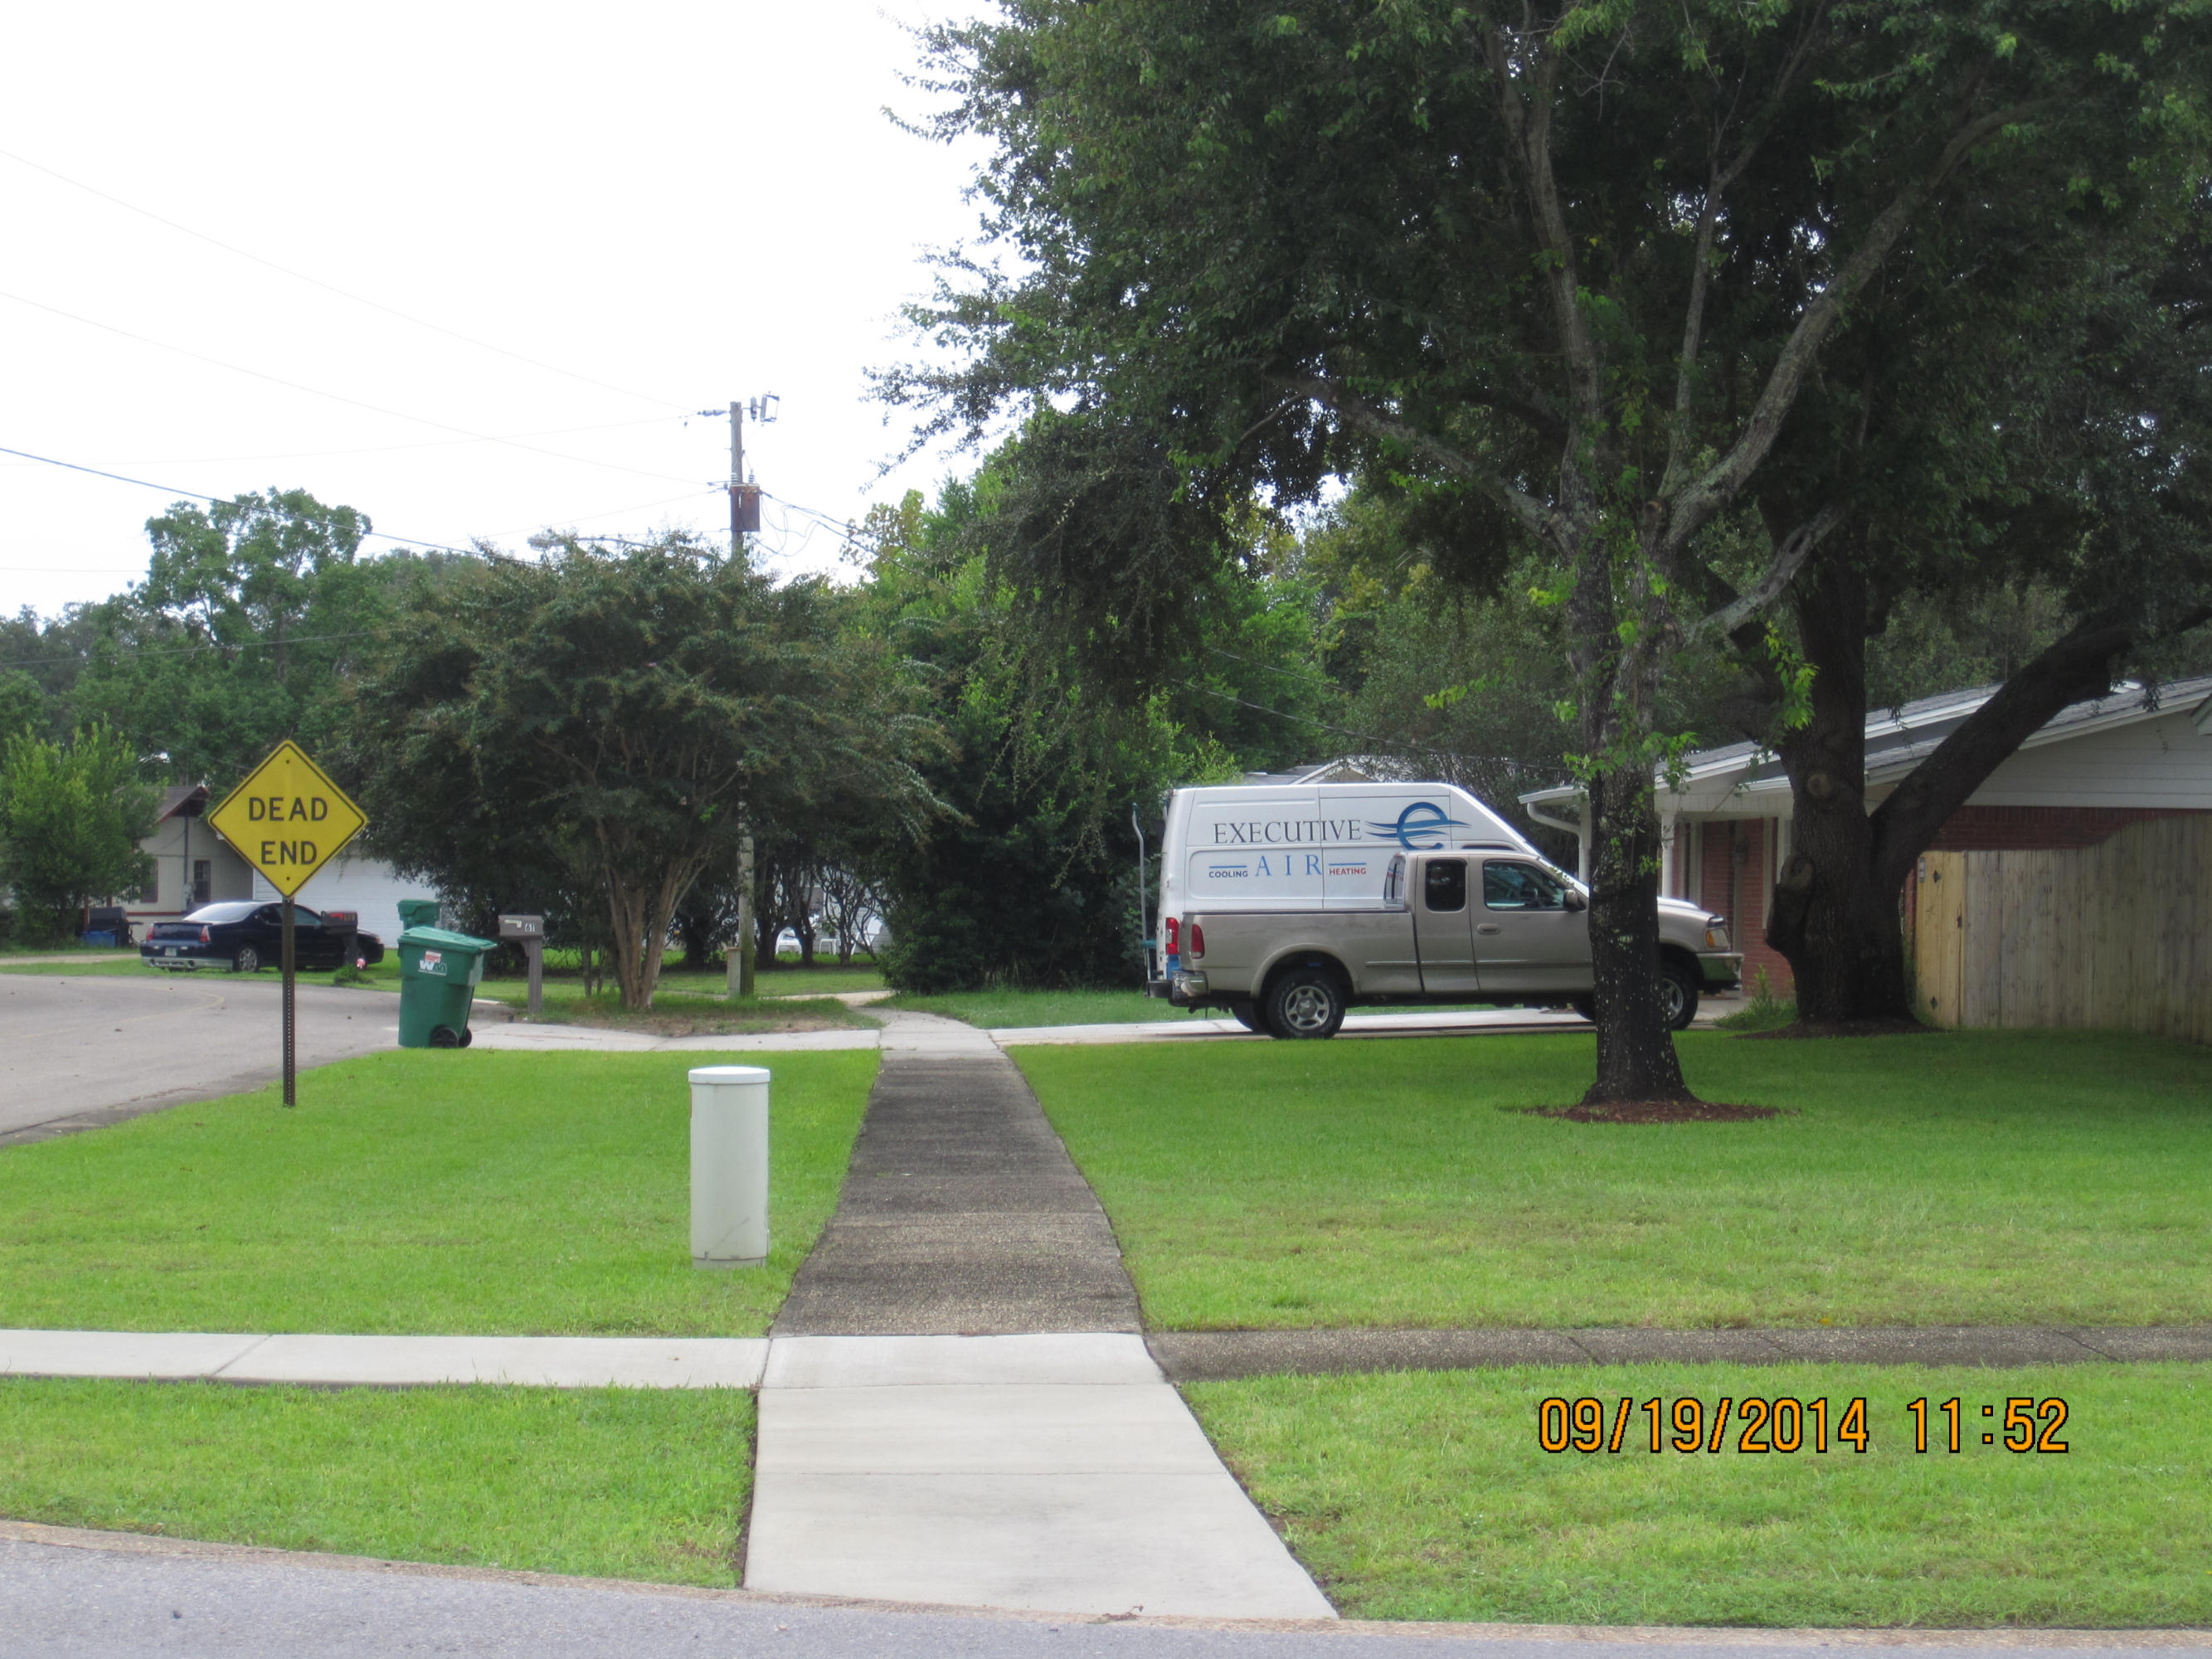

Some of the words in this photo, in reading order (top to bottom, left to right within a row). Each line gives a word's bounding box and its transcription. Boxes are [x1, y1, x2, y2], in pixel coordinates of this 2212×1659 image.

[249, 797, 328, 821] DEAD
[1213, 820, 1362, 844] EXECUTIVE
[260, 840, 318, 865] END
[1208, 870, 1248, 878] COOLING
[1255, 854, 1324, 876] AIR
[1329, 868, 1367, 876] HEATING
